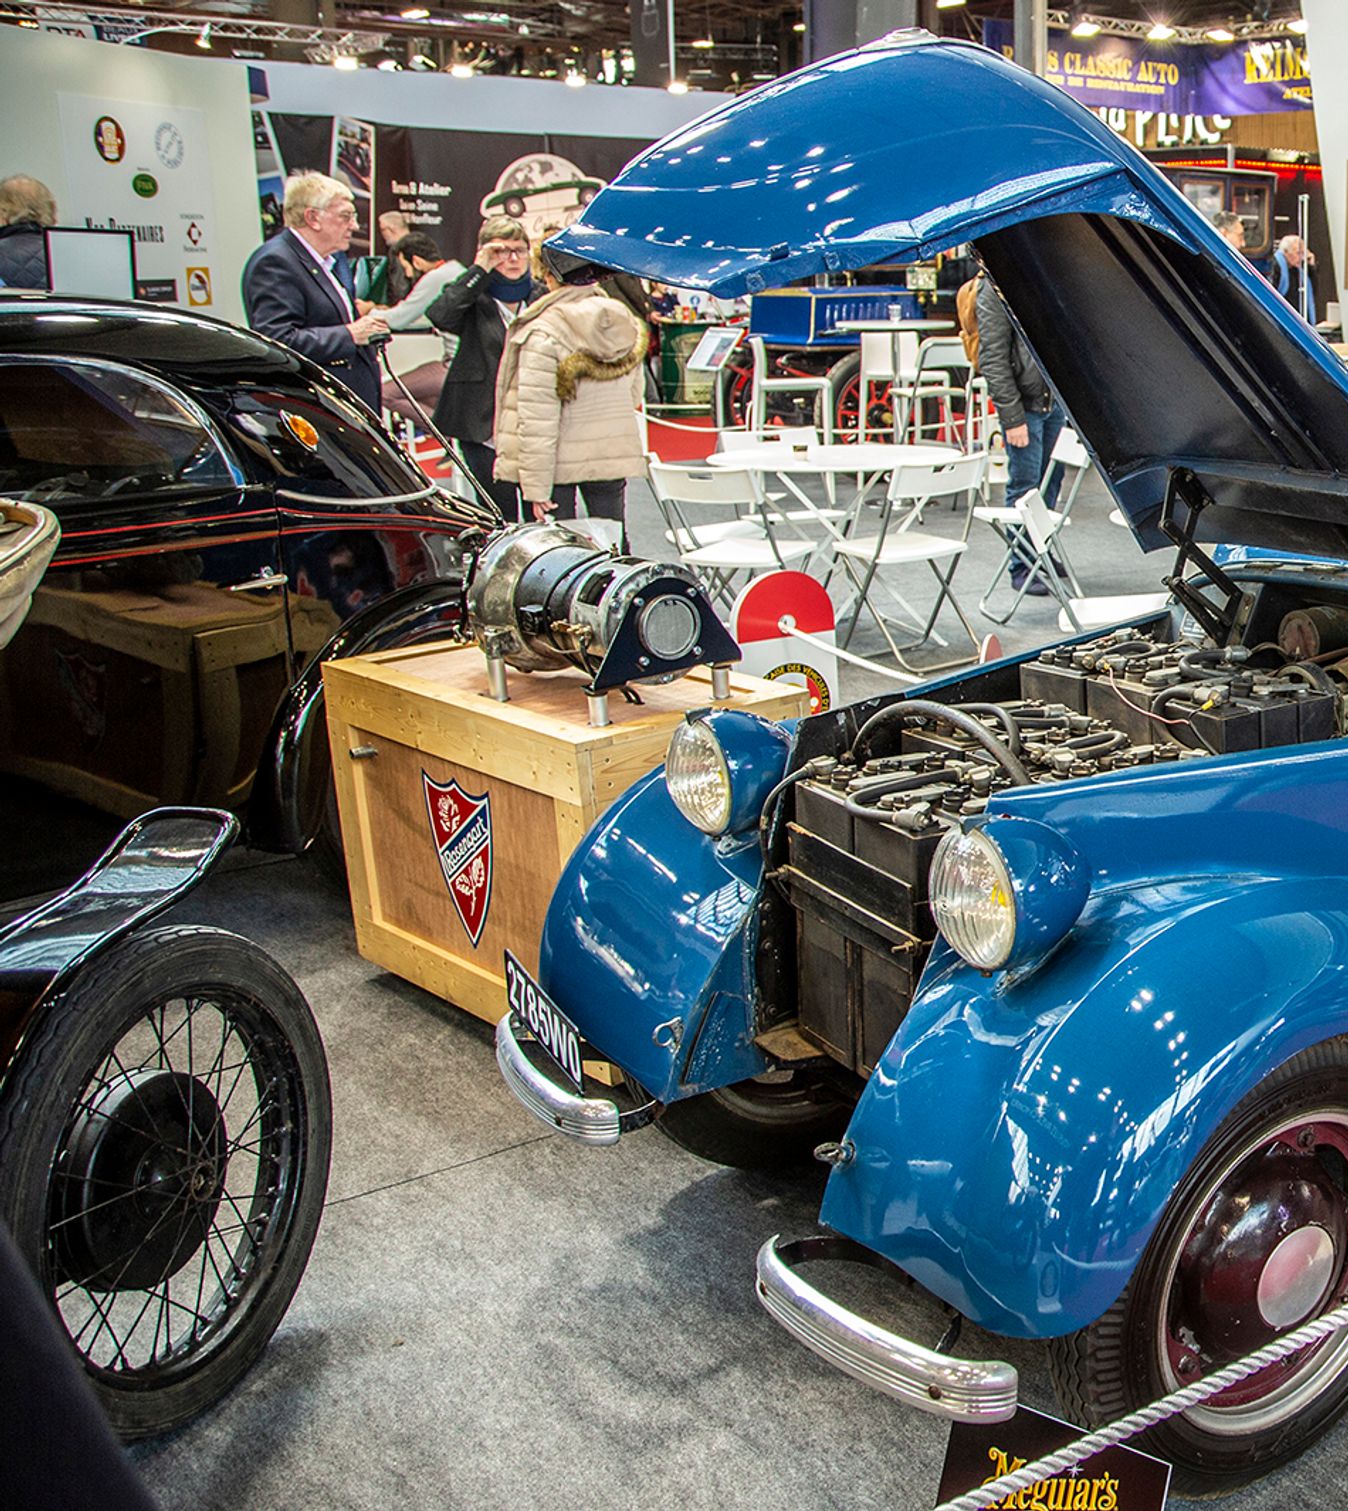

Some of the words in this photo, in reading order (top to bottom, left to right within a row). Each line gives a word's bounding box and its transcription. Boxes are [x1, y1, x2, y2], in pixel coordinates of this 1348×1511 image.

[1064, 52, 1133, 80] CLASSIC
[1137, 61, 1179, 85] AUTO
[442, 816, 487, 872] Rosengart
